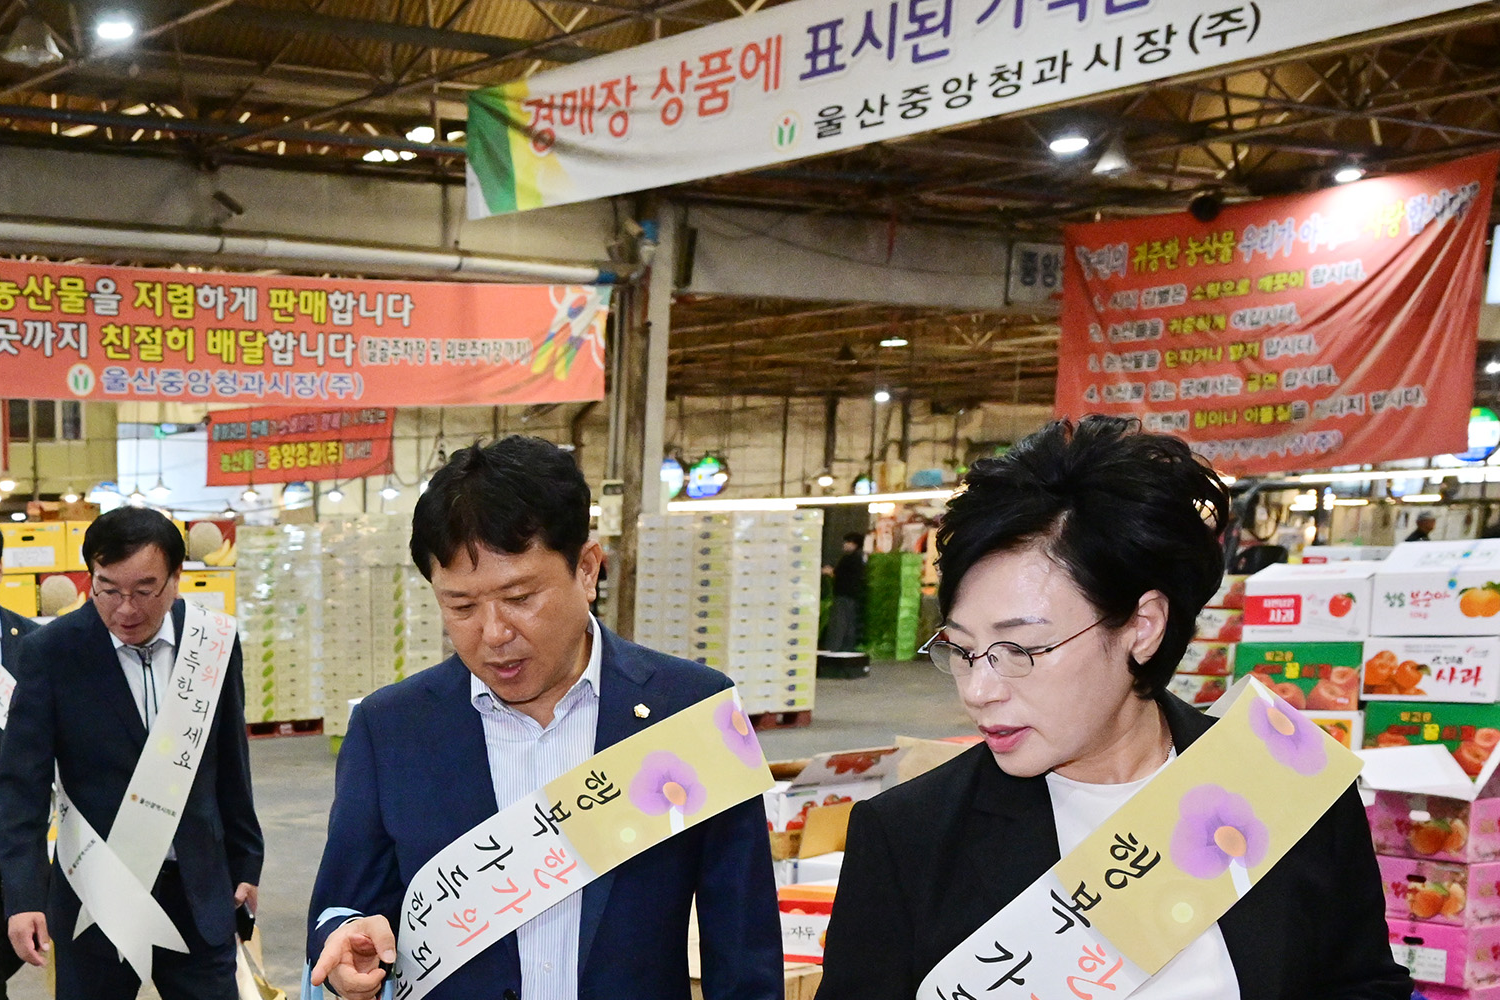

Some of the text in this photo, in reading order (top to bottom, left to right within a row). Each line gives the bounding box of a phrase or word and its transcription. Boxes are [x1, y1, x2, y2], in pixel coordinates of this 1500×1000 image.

[524, 0, 951, 153] 경매장 상품에 표시된
[814, 2, 1262, 139] 울산중앙청과시장(주)
[1132, 236, 1180, 272] 귀중한
[1185, 230, 1236, 267] 농산물
[1241, 217, 1296, 262] 우리가
[133, 280, 259, 322] 저렴하게
[268, 286, 415, 328] 판매합니다
[101, 323, 196, 363] 친절히
[206, 327, 357, 368] 배달합니다
[102, 366, 364, 400] 울산중앙청과시장(주)
[177, 626, 209, 701] 가득한
[199, 614, 233, 690] 한가위
[1436, 665, 1482, 687] 사과
[172, 697, 210, 772] 되세요
[407, 770, 622, 932] 행복 가득한
[1050, 831, 1161, 935] 행복
[446, 847, 577, 948] 한가위
